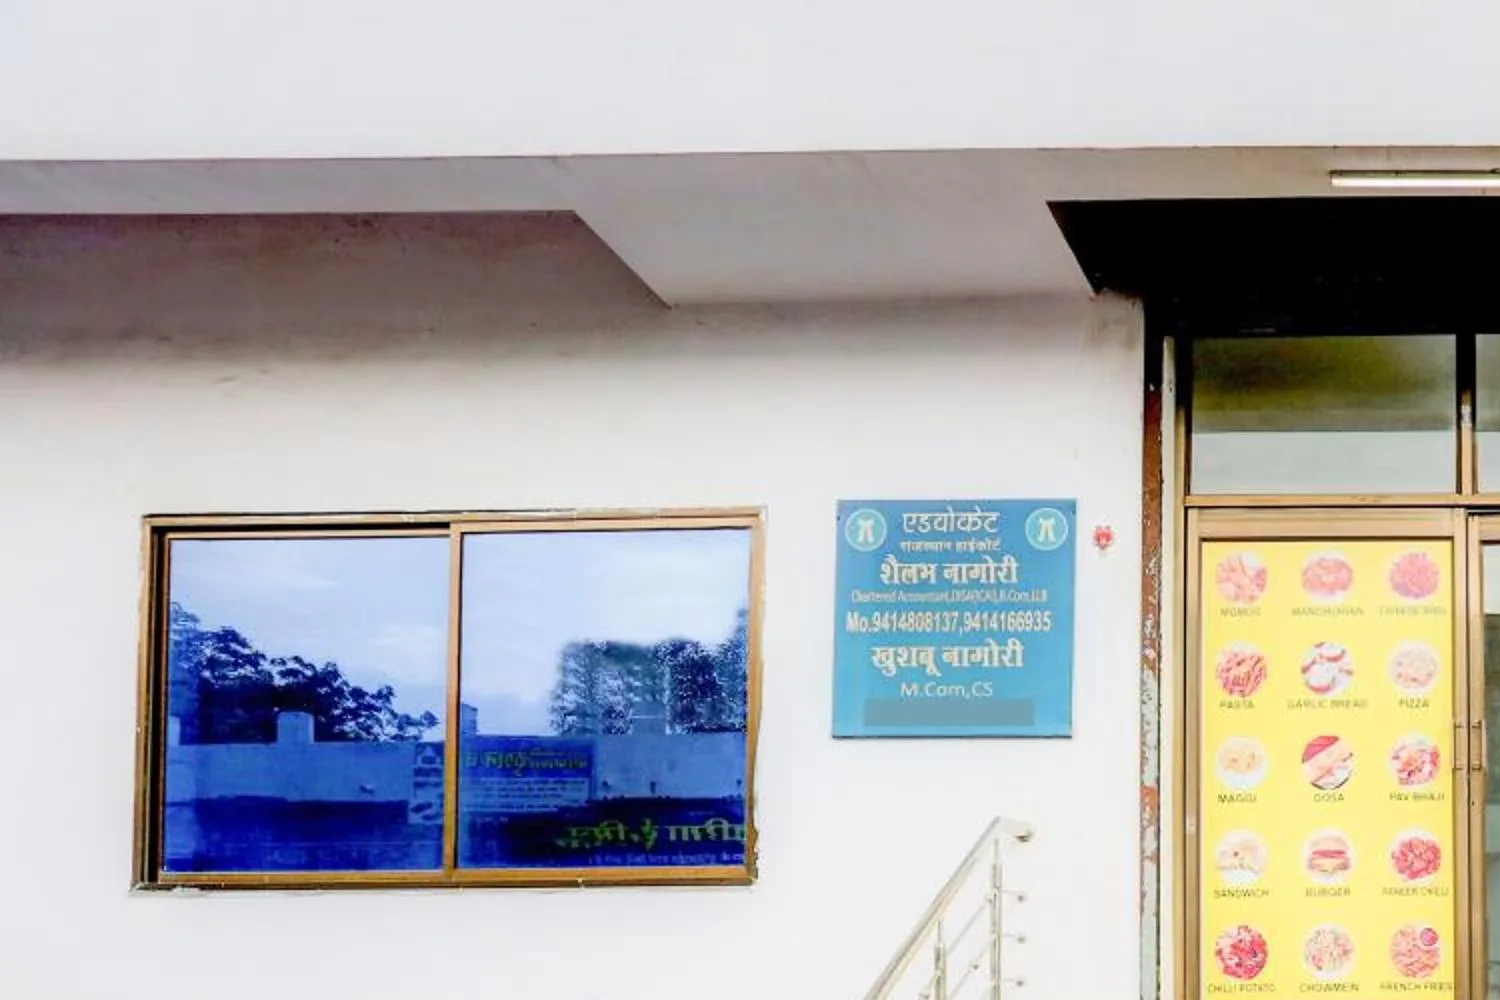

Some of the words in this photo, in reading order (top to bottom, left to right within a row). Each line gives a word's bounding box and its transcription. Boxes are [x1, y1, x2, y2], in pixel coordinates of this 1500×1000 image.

[903, 505, 1000, 533] एडवोकेट
[943, 553, 1019, 584] नागोरी
[942, 638, 1024, 668] नागोरी
